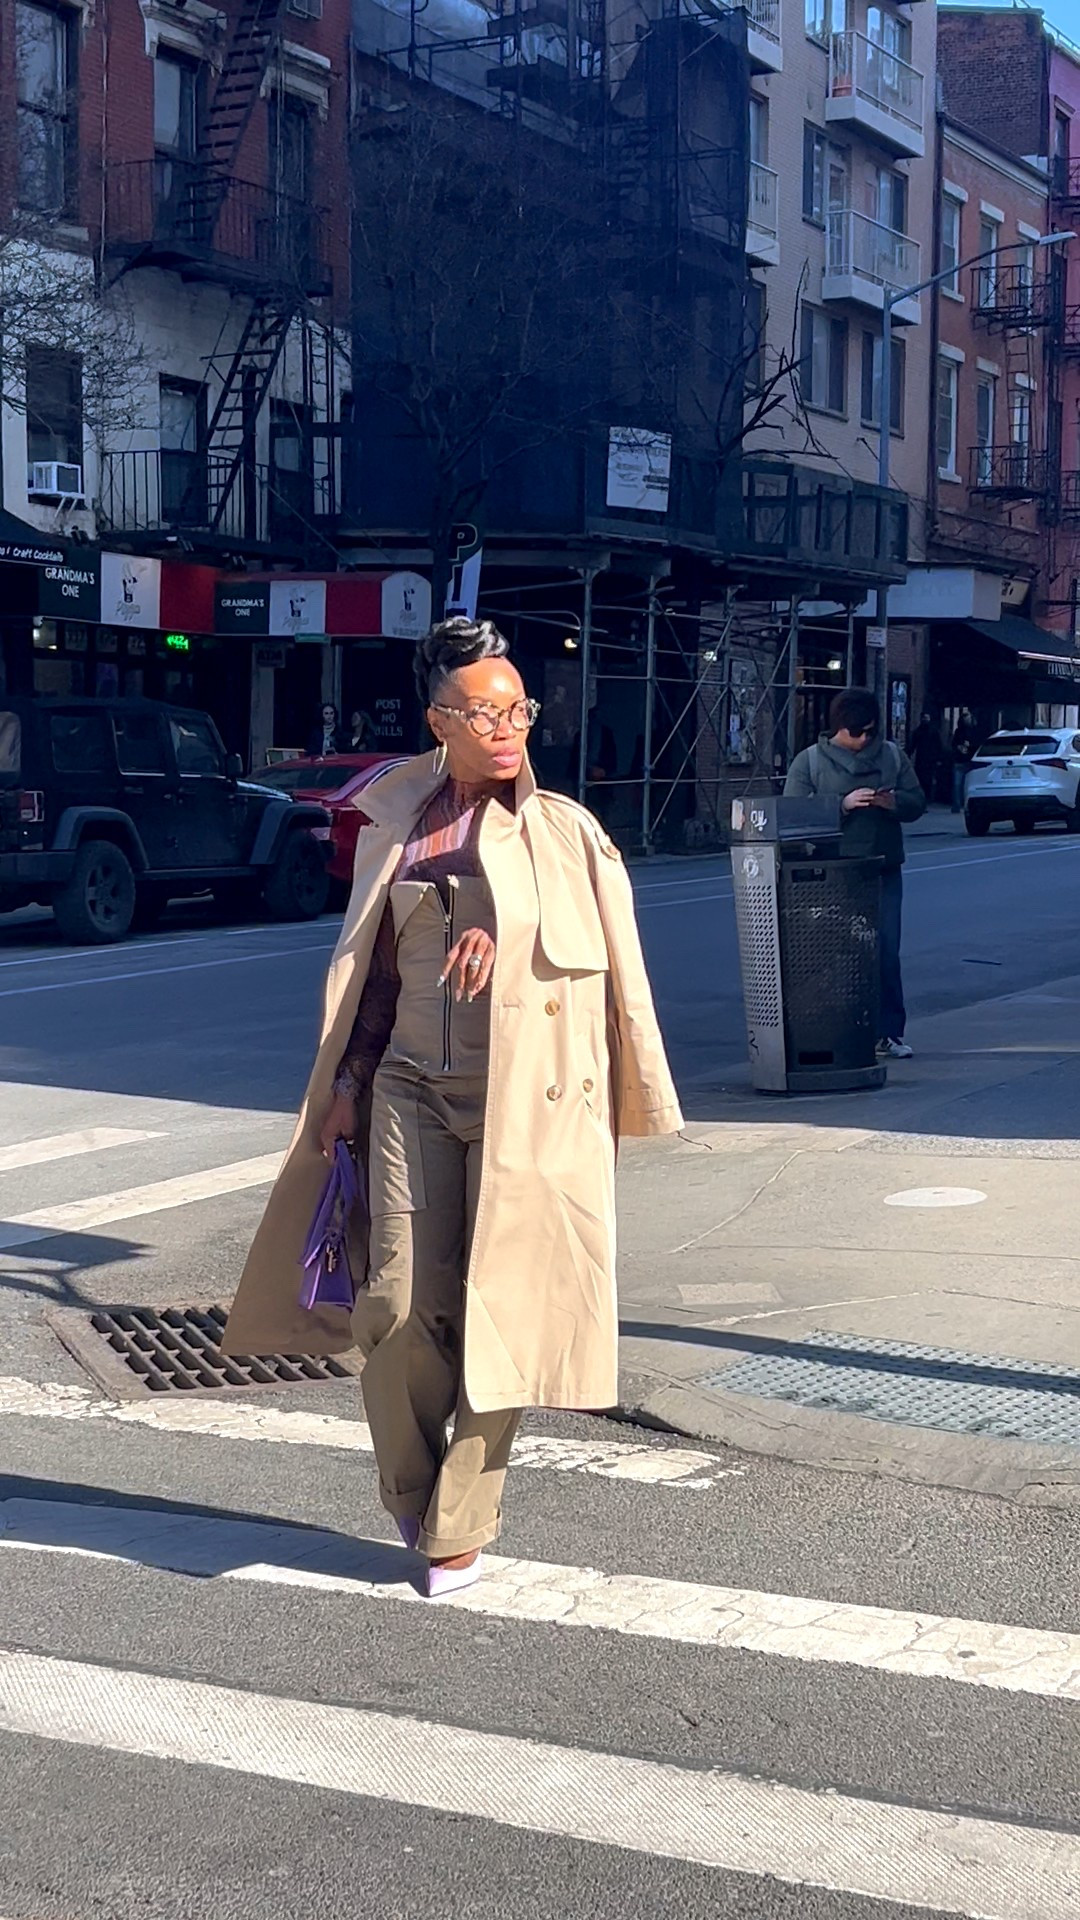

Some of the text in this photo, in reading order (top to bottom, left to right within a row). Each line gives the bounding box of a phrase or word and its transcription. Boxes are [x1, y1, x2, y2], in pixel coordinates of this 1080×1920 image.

[13, 547, 33, 559] Craft
[33, 549, 64, 563] Cocktails
[45, 567, 95, 585] GRANDMA'S
[62, 584, 80, 598] ONE
[221, 598, 265, 608] GRANDMA'S
[235, 608, 250, 617] ONE
[375, 698, 401, 710] POST
[381, 712, 396, 723] NO
